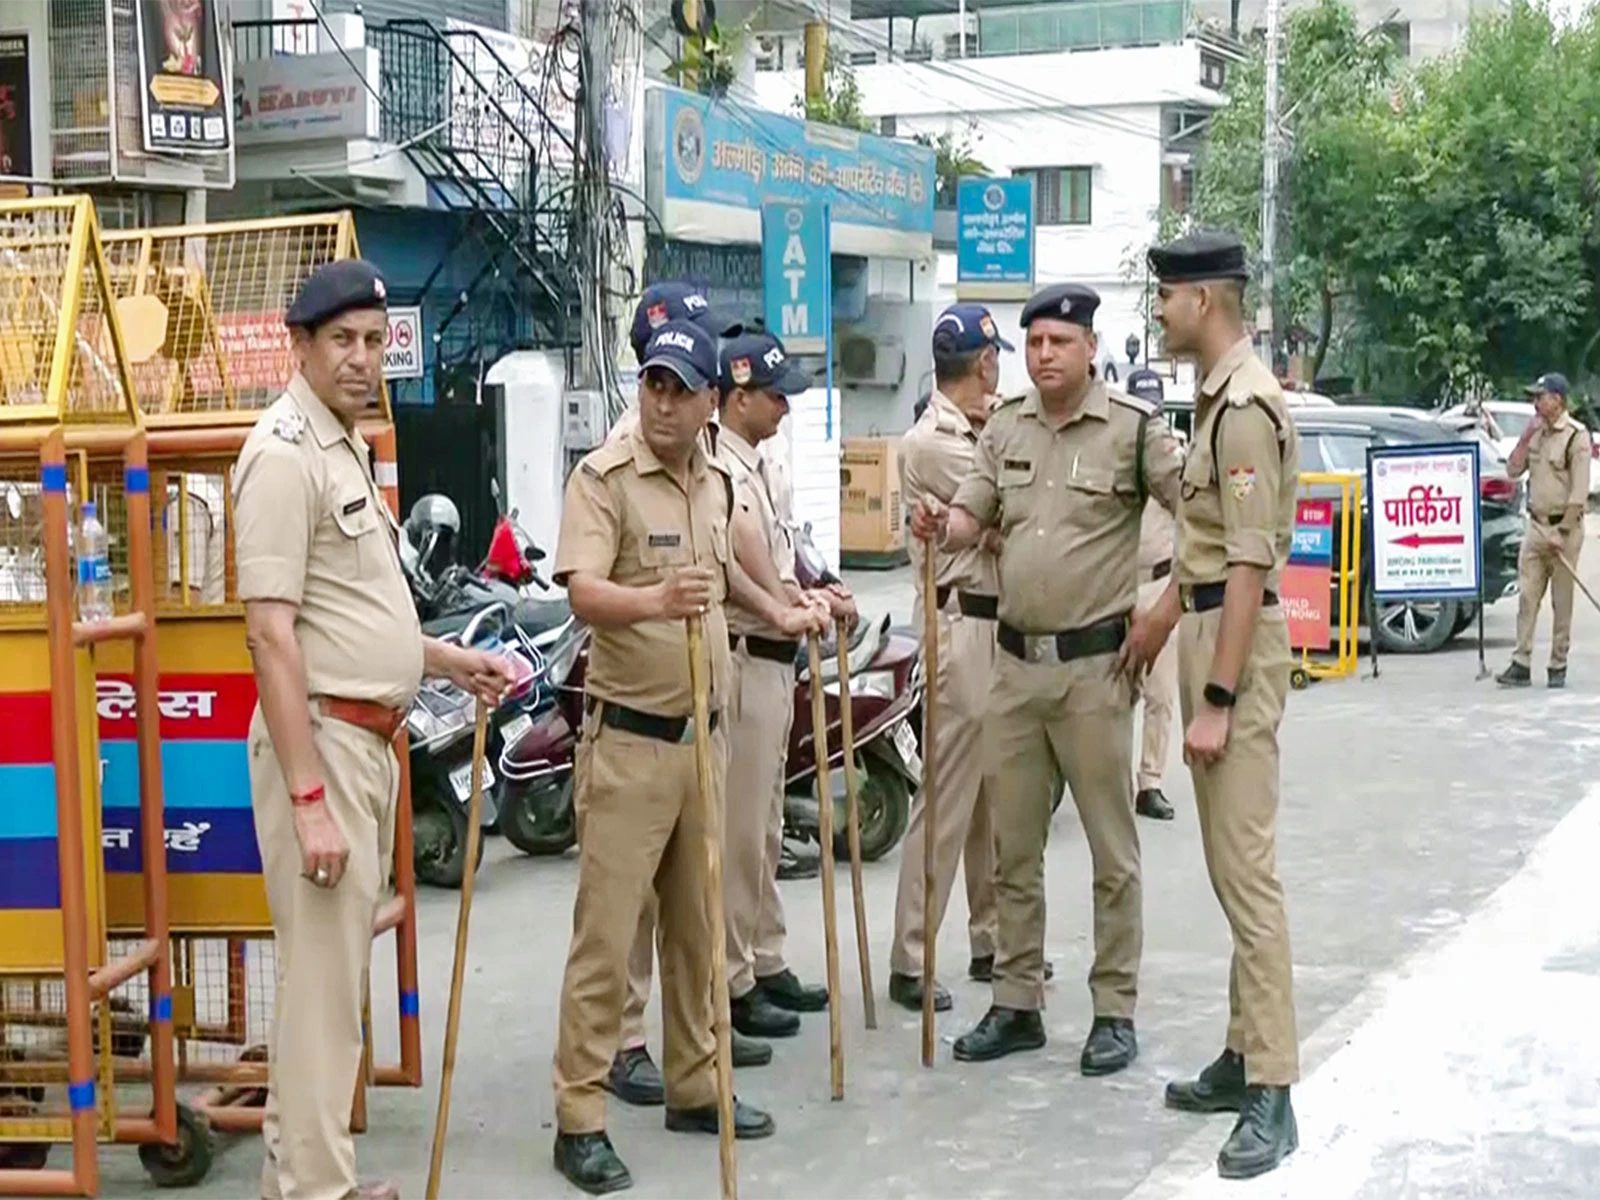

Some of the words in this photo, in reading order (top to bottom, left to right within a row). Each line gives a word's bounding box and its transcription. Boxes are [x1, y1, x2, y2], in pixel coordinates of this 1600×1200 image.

[781, 234, 808, 335] ATM
[655, 331, 695, 353] POLICE
[1383, 484, 1462, 527] पार्किंग
